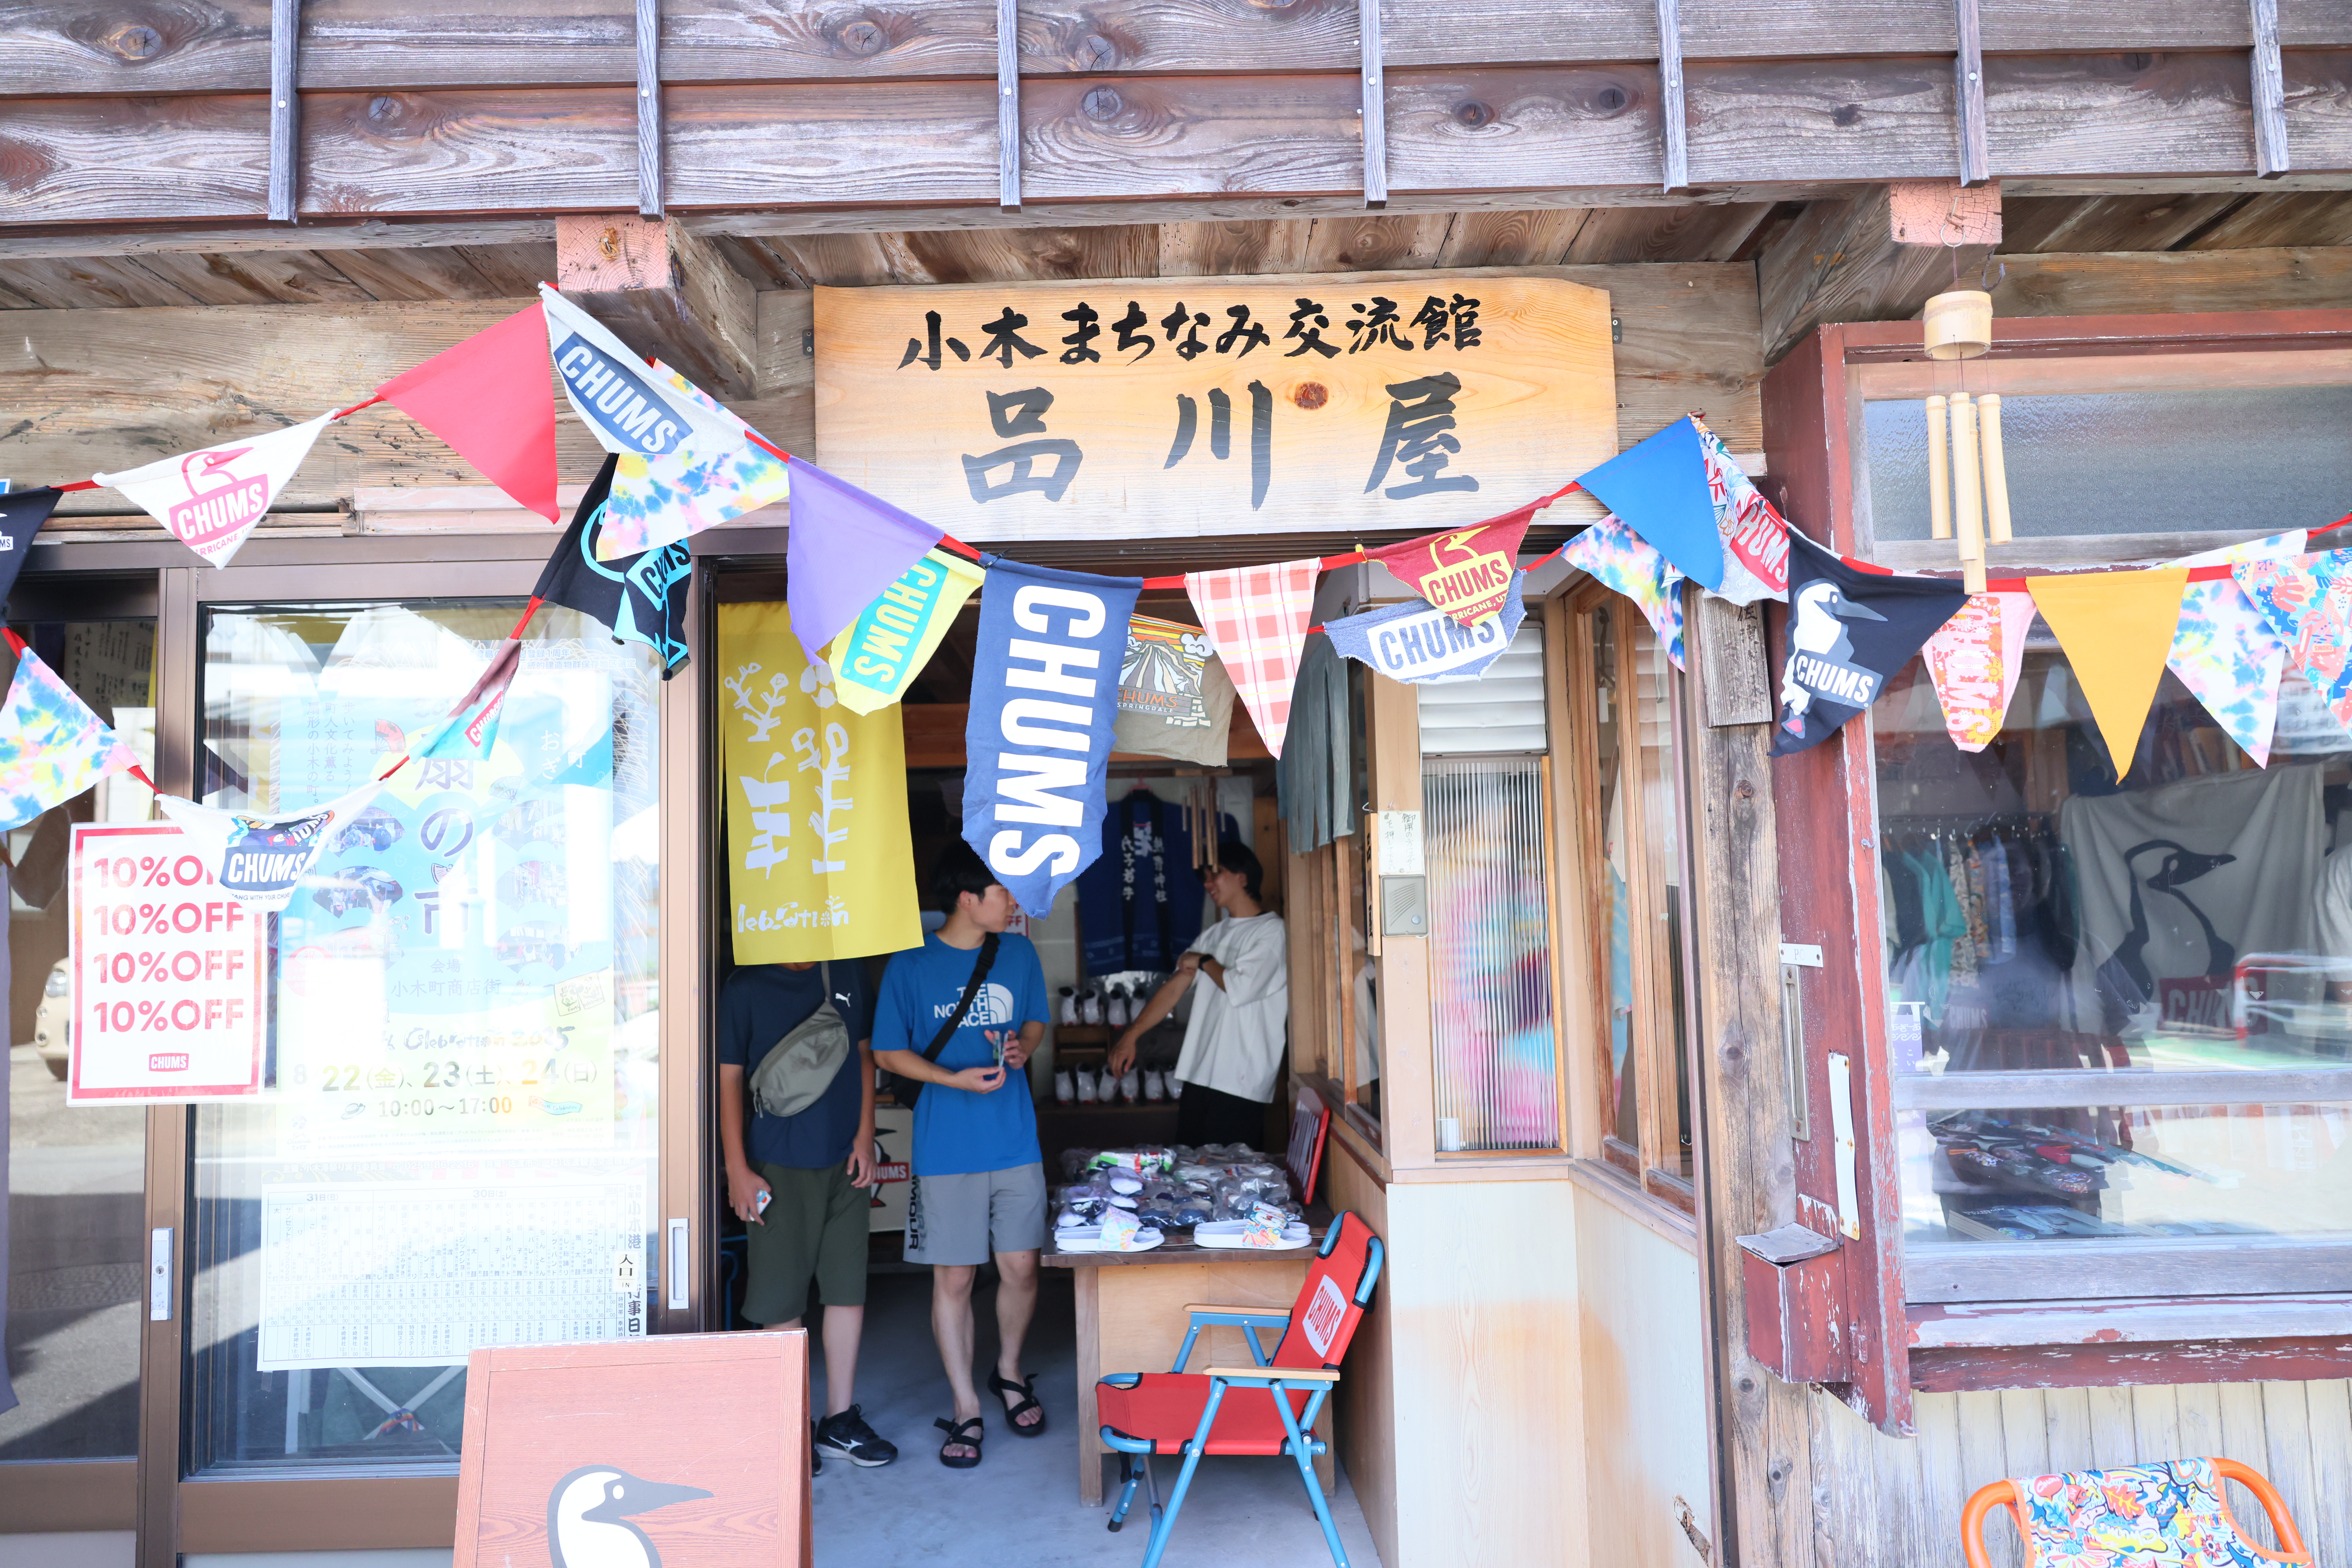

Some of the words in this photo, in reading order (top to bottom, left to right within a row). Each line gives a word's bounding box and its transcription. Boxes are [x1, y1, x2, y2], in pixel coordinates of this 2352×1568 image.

[897, 292, 1482, 370] 小木まちなみ交流館
[559, 345, 679, 453] CHUMS
[961, 371, 1479, 512] 品川屋
[178, 483, 263, 539] CHUMS
[195, 533, 240, 556] RRICANE,
[1734, 504, 1790, 583] HUMS
[1428, 559, 1508, 606] CHUMS
[854, 564, 937, 682] CHUMS
[1379, 614, 1495, 669] CHUMS
[1796, 655, 1874, 703] CHUMS
[1946, 607, 1992, 734] CHUMS
[1117, 689, 1178, 707] HUMS
[1117, 702, 1174, 713] SPRINGDALE
[989, 585, 1106, 877] CHUMS
[228, 852, 307, 883] CHUMS
[94, 902, 244, 935] 10%OFF
[94, 950, 243, 983] 10%OFF
[430, 958, 461, 974] 会場
[391, 978, 501, 998] 小木町商店街
[957, 983, 987, 999] TE
[94, 999, 243, 1032] 10%OFF
[957, 1012, 990, 1028] ACE
[151, 1055, 187, 1069] CHUMS
[618, 1254, 633, 1276] 入口
[1308, 1287, 1340, 1346] CHUMS
